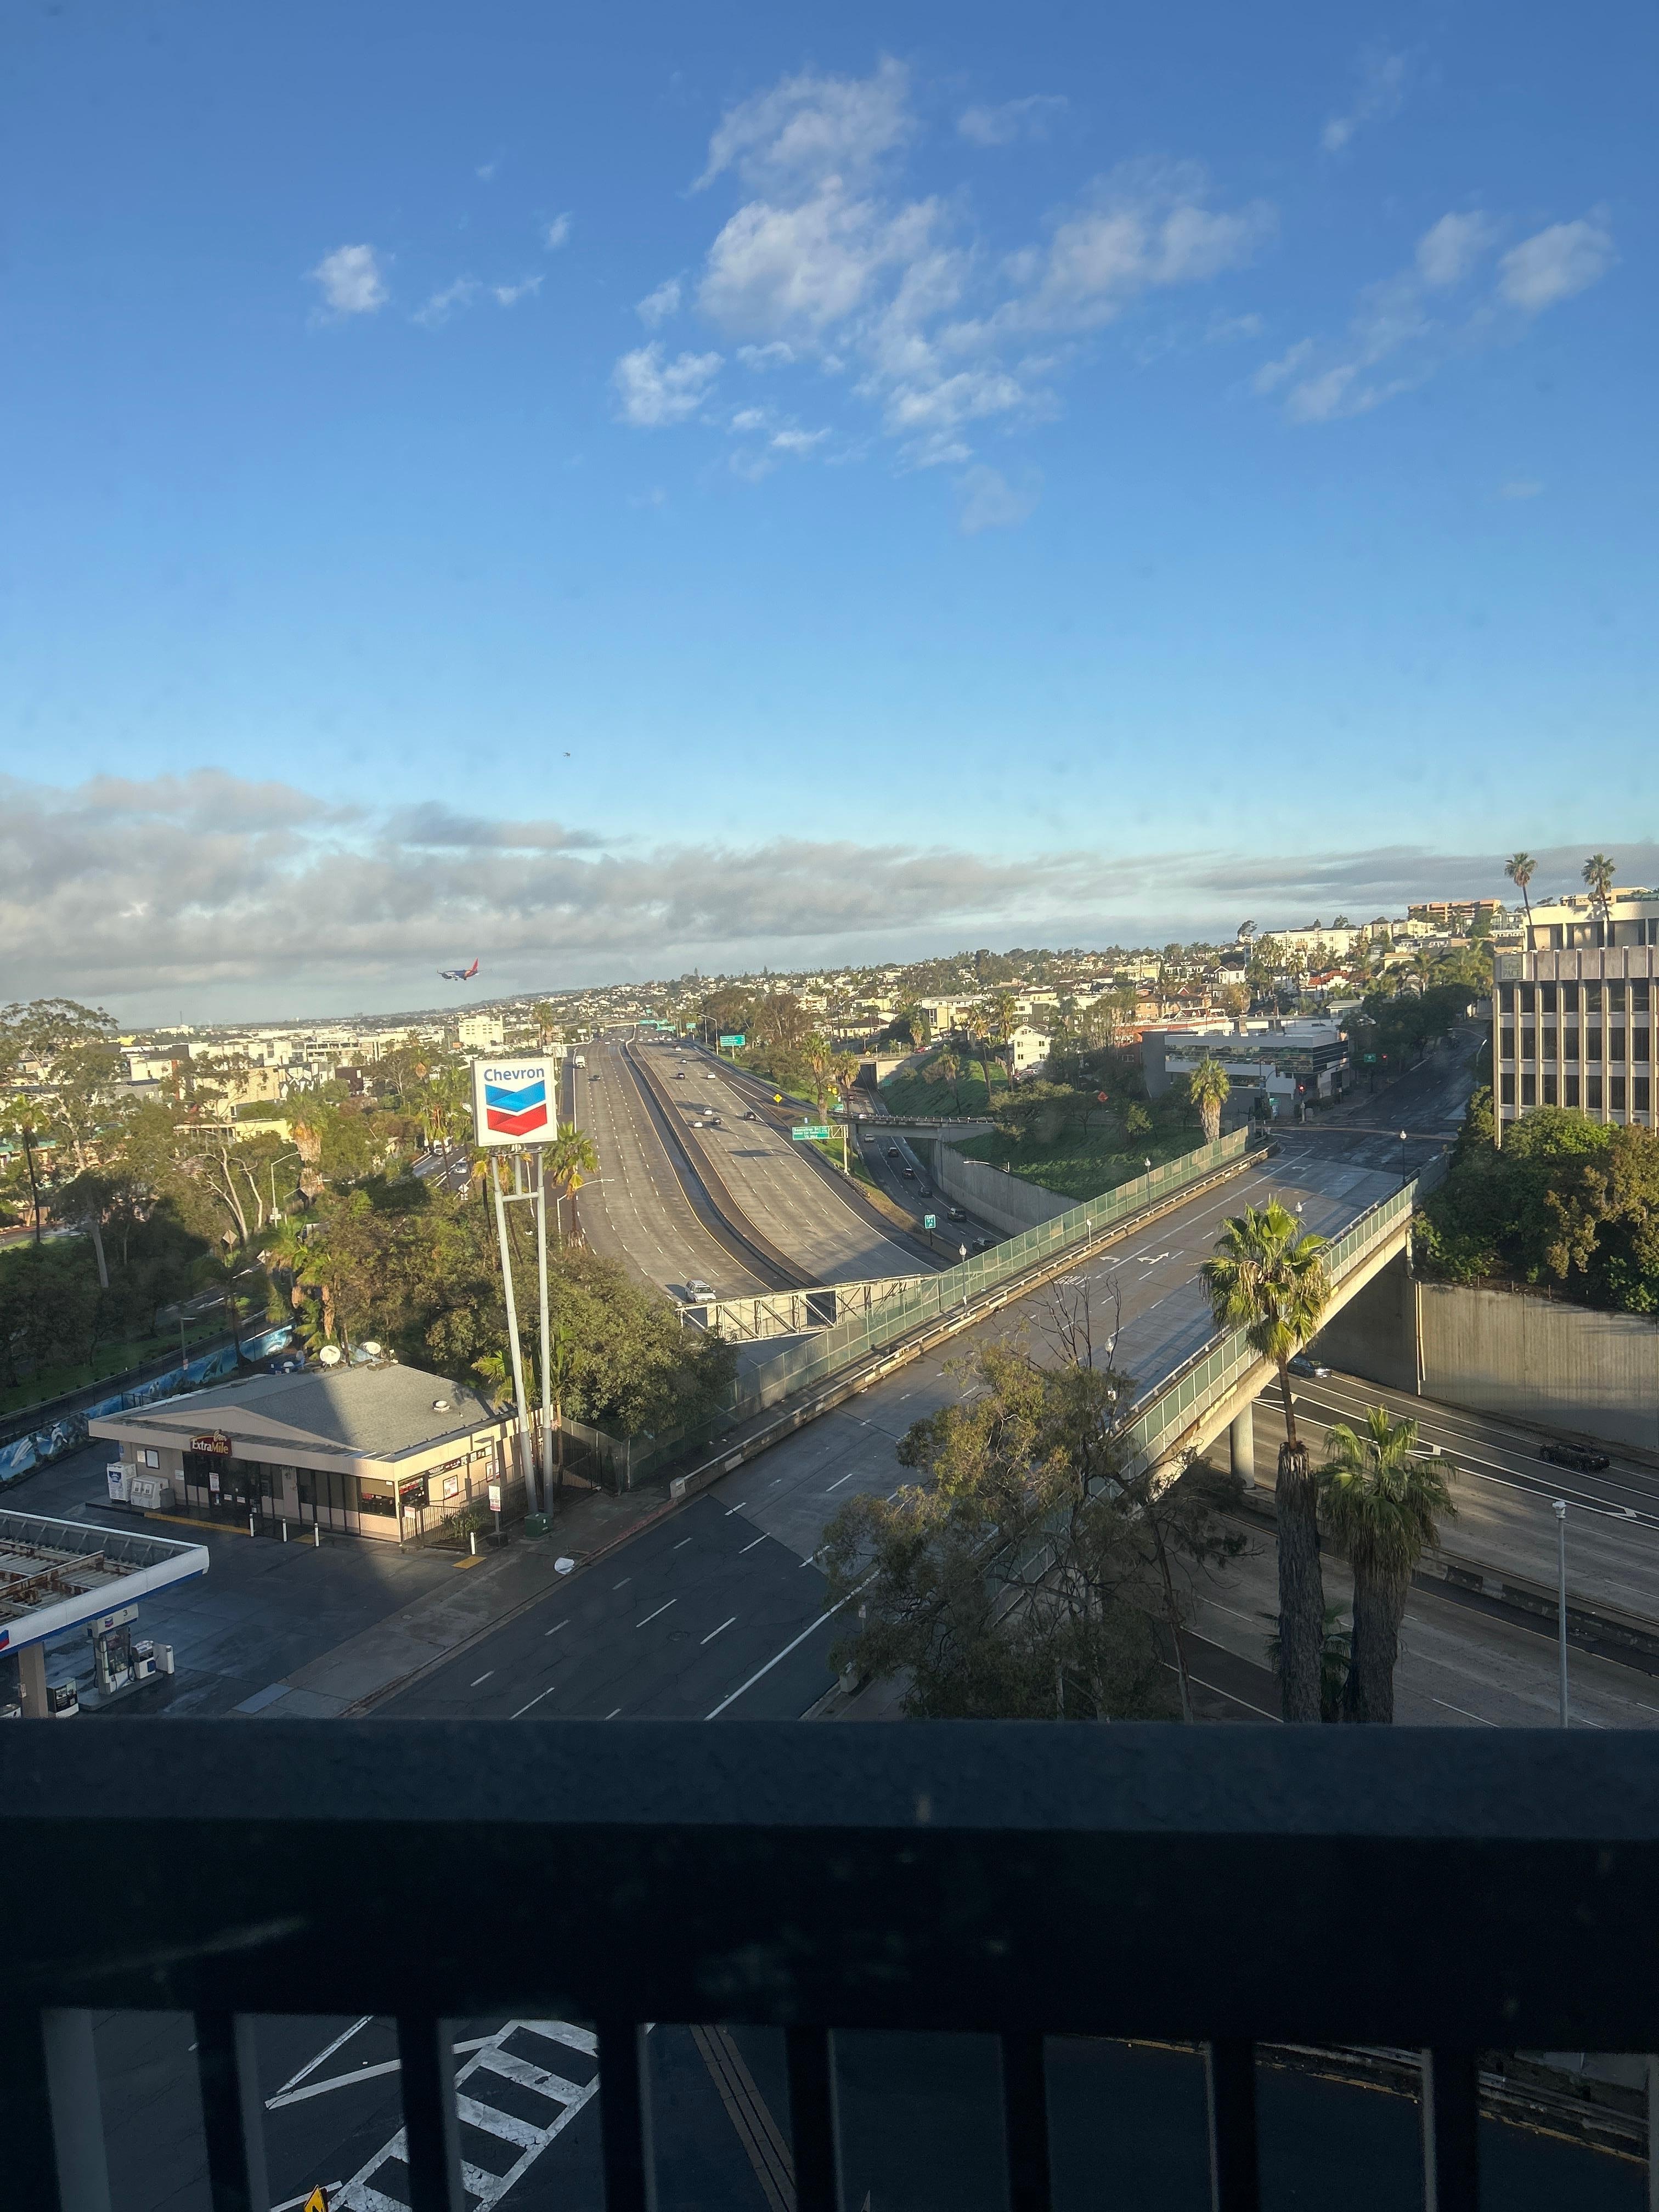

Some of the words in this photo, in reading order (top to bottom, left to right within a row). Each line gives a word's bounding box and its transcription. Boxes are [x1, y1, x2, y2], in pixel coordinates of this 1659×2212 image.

[1503, 969, 1521, 978] PACE
[484, 1068, 545, 1081] Chevron
[193, 1439, 229, 1454] ExtraMile
